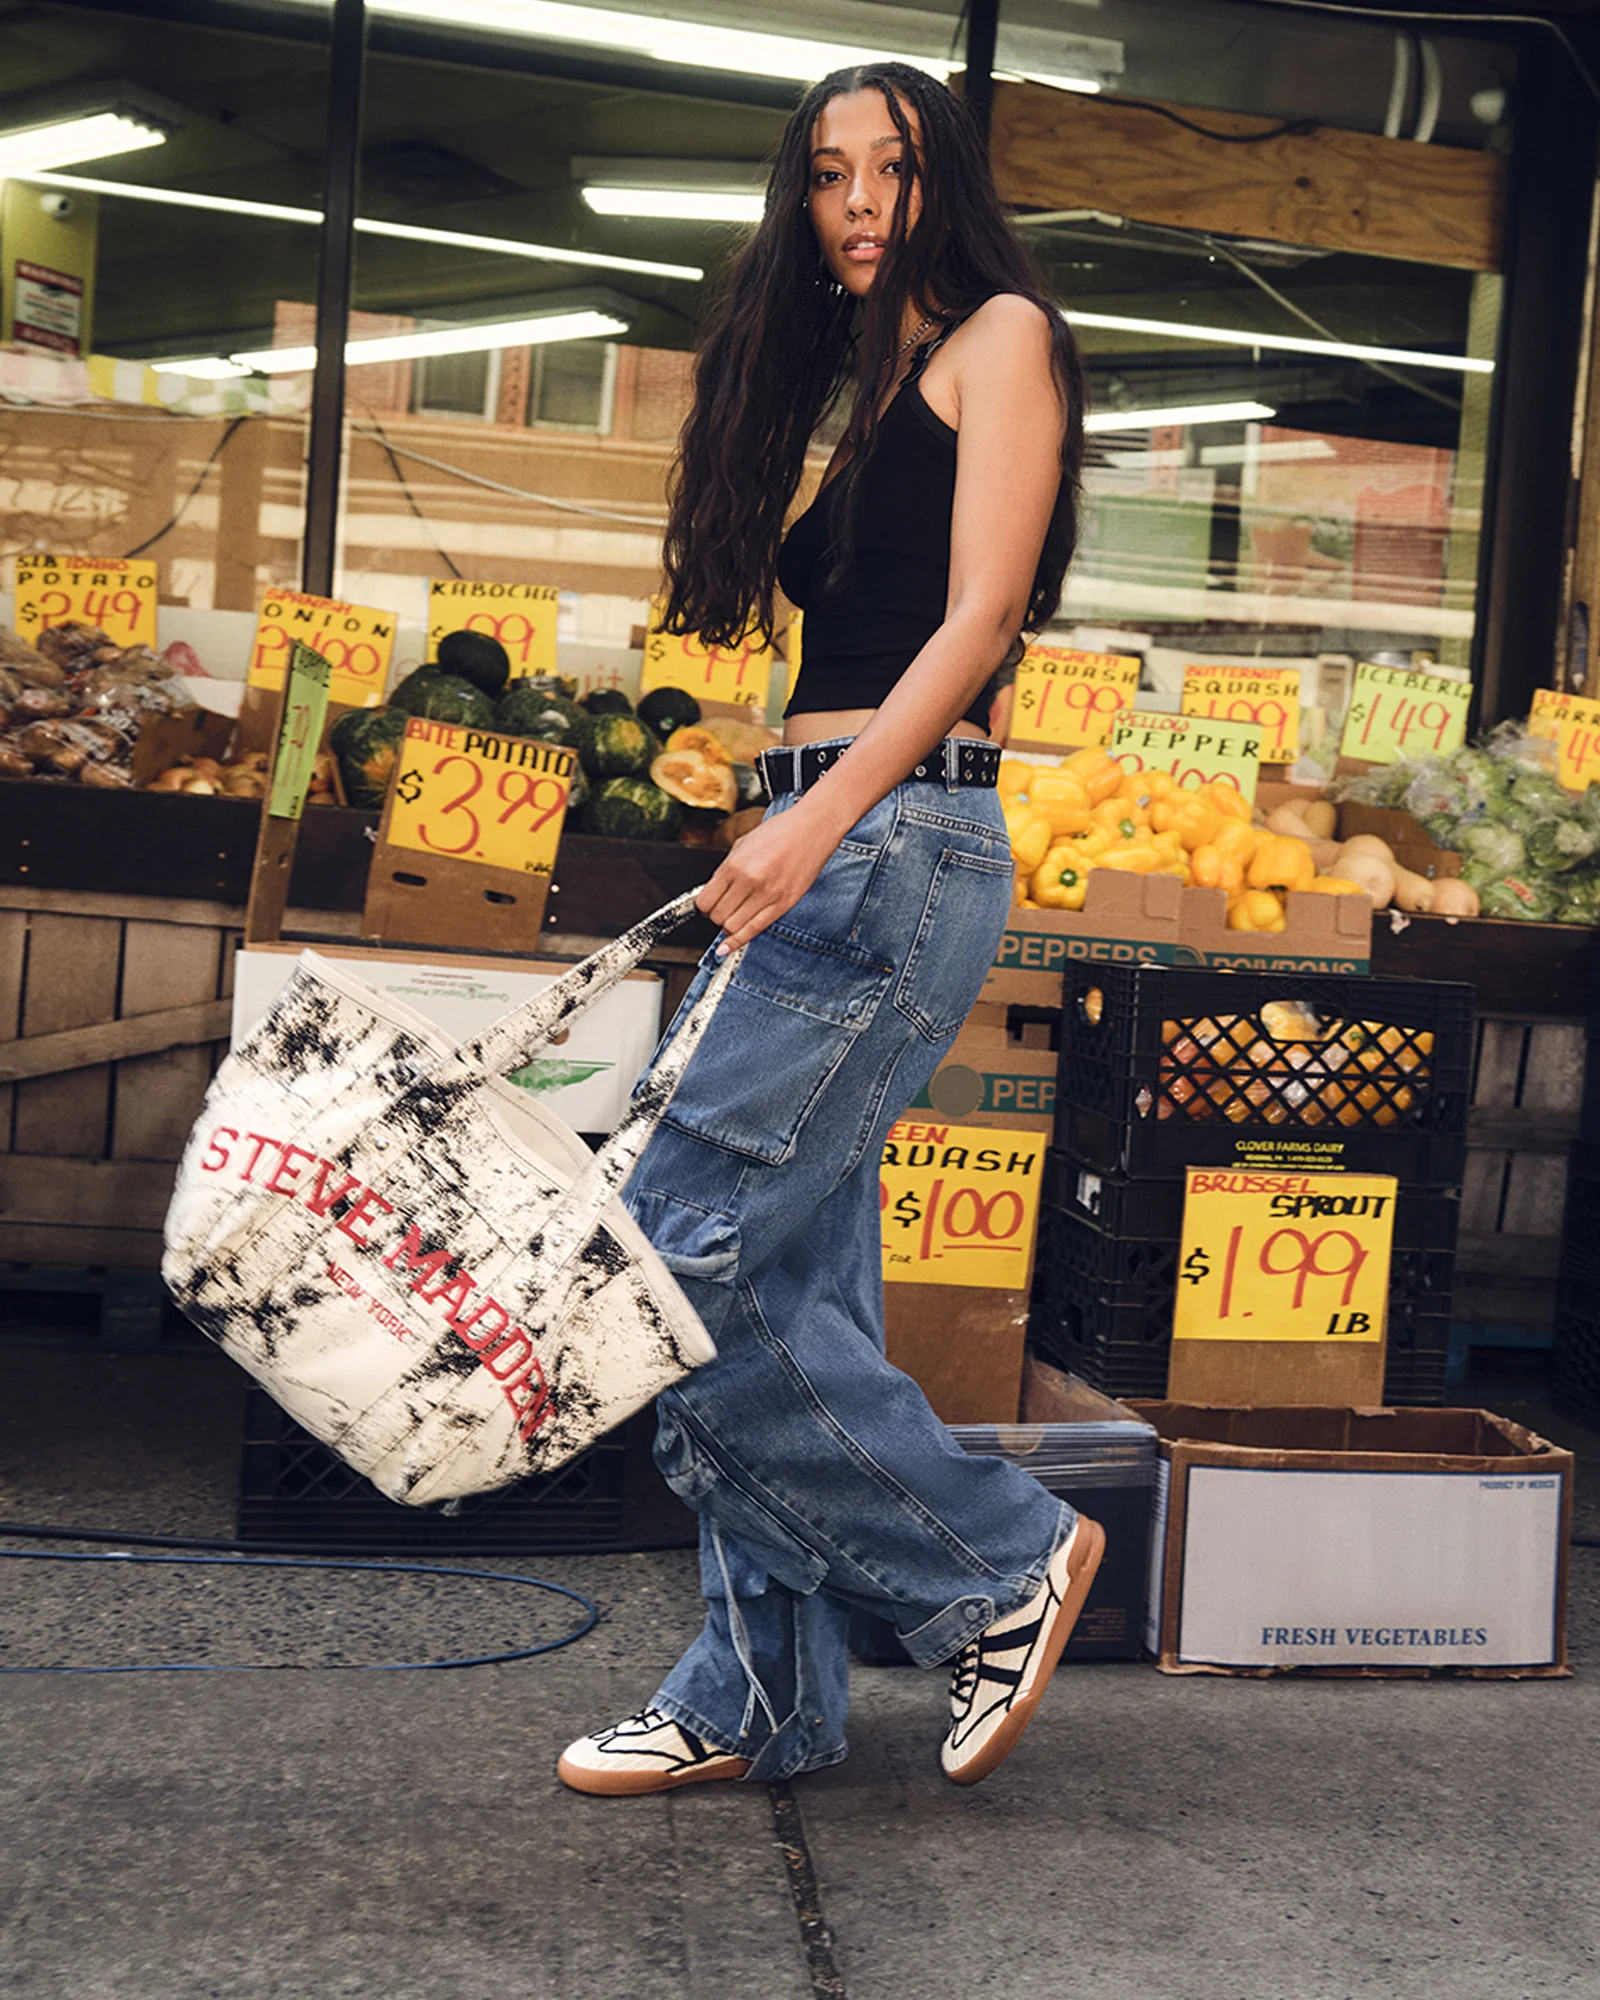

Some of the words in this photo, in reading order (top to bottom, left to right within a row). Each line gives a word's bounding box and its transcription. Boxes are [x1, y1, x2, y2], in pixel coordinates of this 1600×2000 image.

[18, 571, 155, 588] POTATO
[430, 582, 559, 602] KABOCHA
[263, 602, 391, 638] ONION
[1018, 658, 1140, 685] SQUASH
[1182, 679, 1300, 697] SQUASH
[1115, 709, 1190, 732] YELLOW
[1535, 704, 1600, 727] CARR
[464, 732, 576, 778] POTATO
[1115, 728, 1261, 759] PEPPER
[1269, 747, 1295, 761] LB
[997, 935, 1158, 967] PEPPERS
[992, 1079, 1057, 1110] PEP
[887, 1123, 949, 1145] EEN
[1235, 1140, 1275, 1152] CLOVER
[1277, 1141, 1312, 1153] FARMS
[1313, 1142, 1345, 1154] DAIRY
[880, 1143, 1037, 1175] QUASH
[1190, 1174, 1319, 1195] BRUSSEL
[1269, 1194, 1392, 1219] SPROUT
[888, 1253, 912, 1265] FOR
[199, 1125, 394, 1250] STEVE
[381, 1222, 555, 1443] MADDEN
[323, 1260, 365, 1304] NEW
[366, 1294, 416, 1344] YORK
[1326, 1312, 1372, 1336] LB
[1261, 1626, 1337, 1647] FRESH
[1345, 1627, 1489, 1647] VEGETABLES
